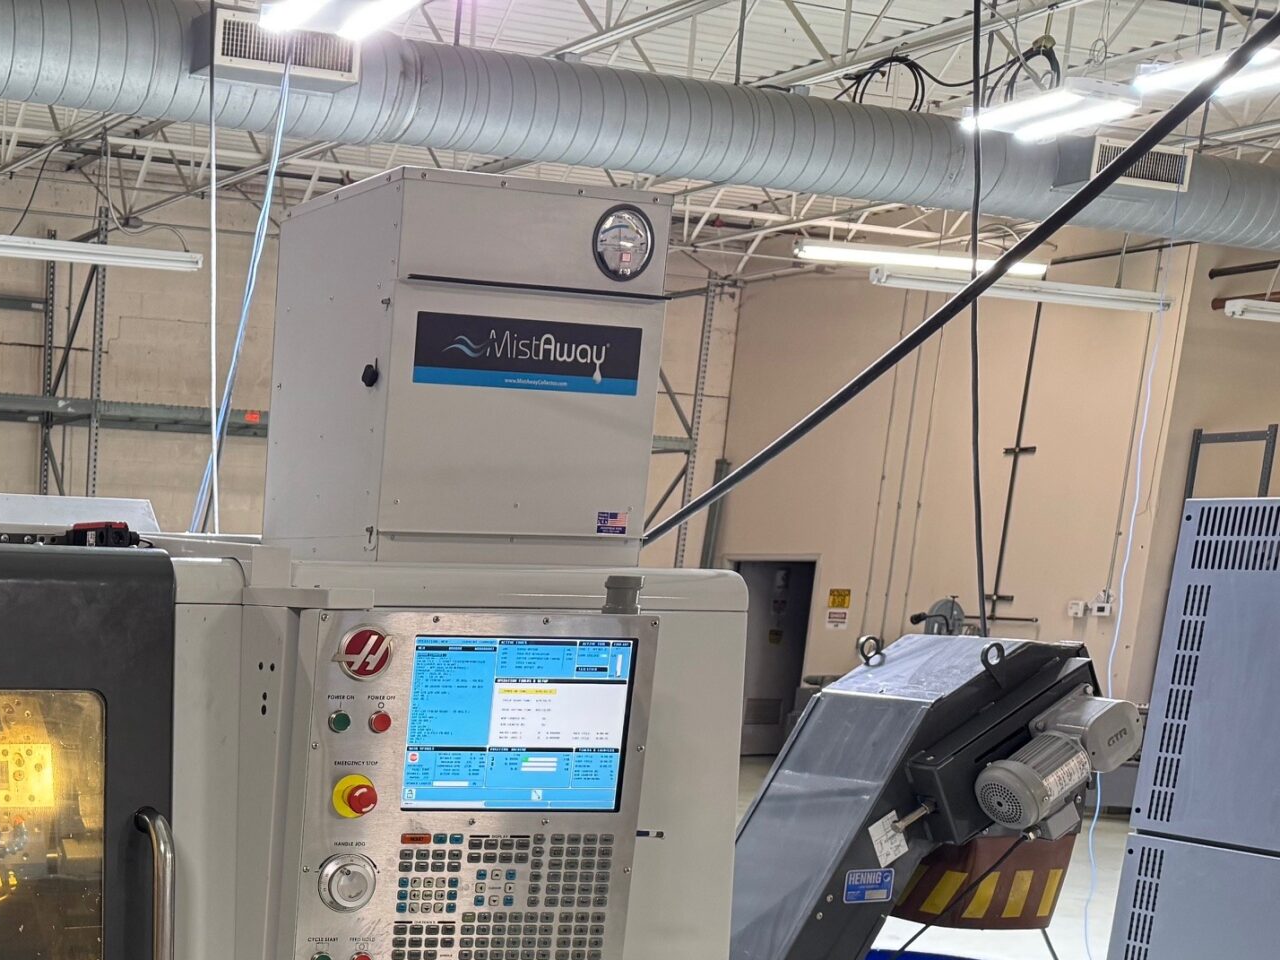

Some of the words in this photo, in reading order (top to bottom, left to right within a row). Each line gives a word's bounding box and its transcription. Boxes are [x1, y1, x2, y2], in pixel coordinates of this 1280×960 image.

[486, 329, 608, 382] MistAway
[1107, 727, 1128, 747] GTR
[848, 872, 882, 885] HENNIG
